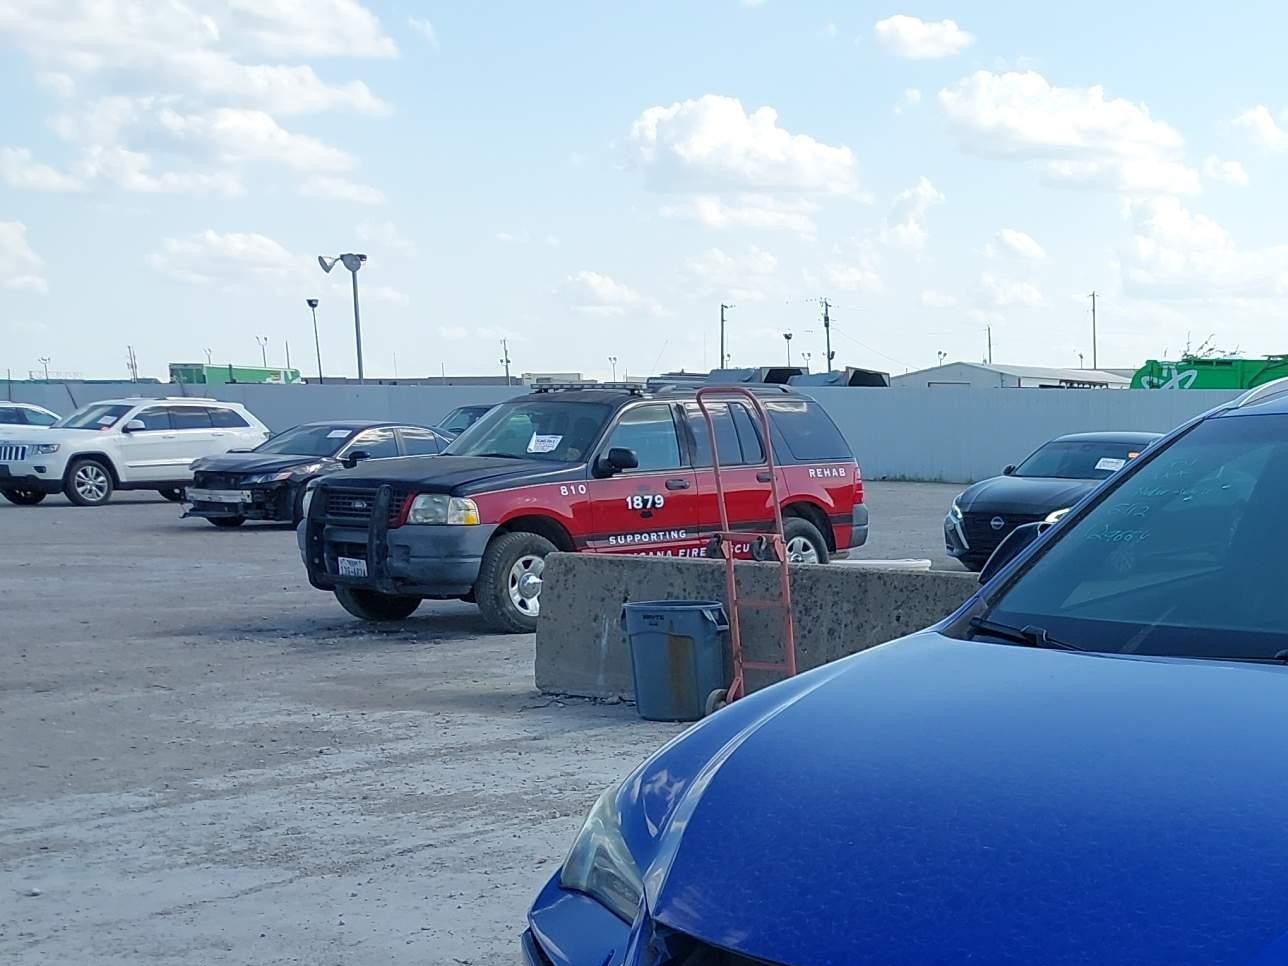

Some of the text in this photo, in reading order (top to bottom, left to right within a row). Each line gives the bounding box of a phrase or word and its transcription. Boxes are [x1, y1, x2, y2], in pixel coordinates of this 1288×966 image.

[808, 468, 846, 478] REHAB
[560, 484, 587, 496] 810
[625, 494, 665, 510] 1879
[608, 529, 688, 545] SUPPORTING
[678, 547, 707, 558] FIRE
